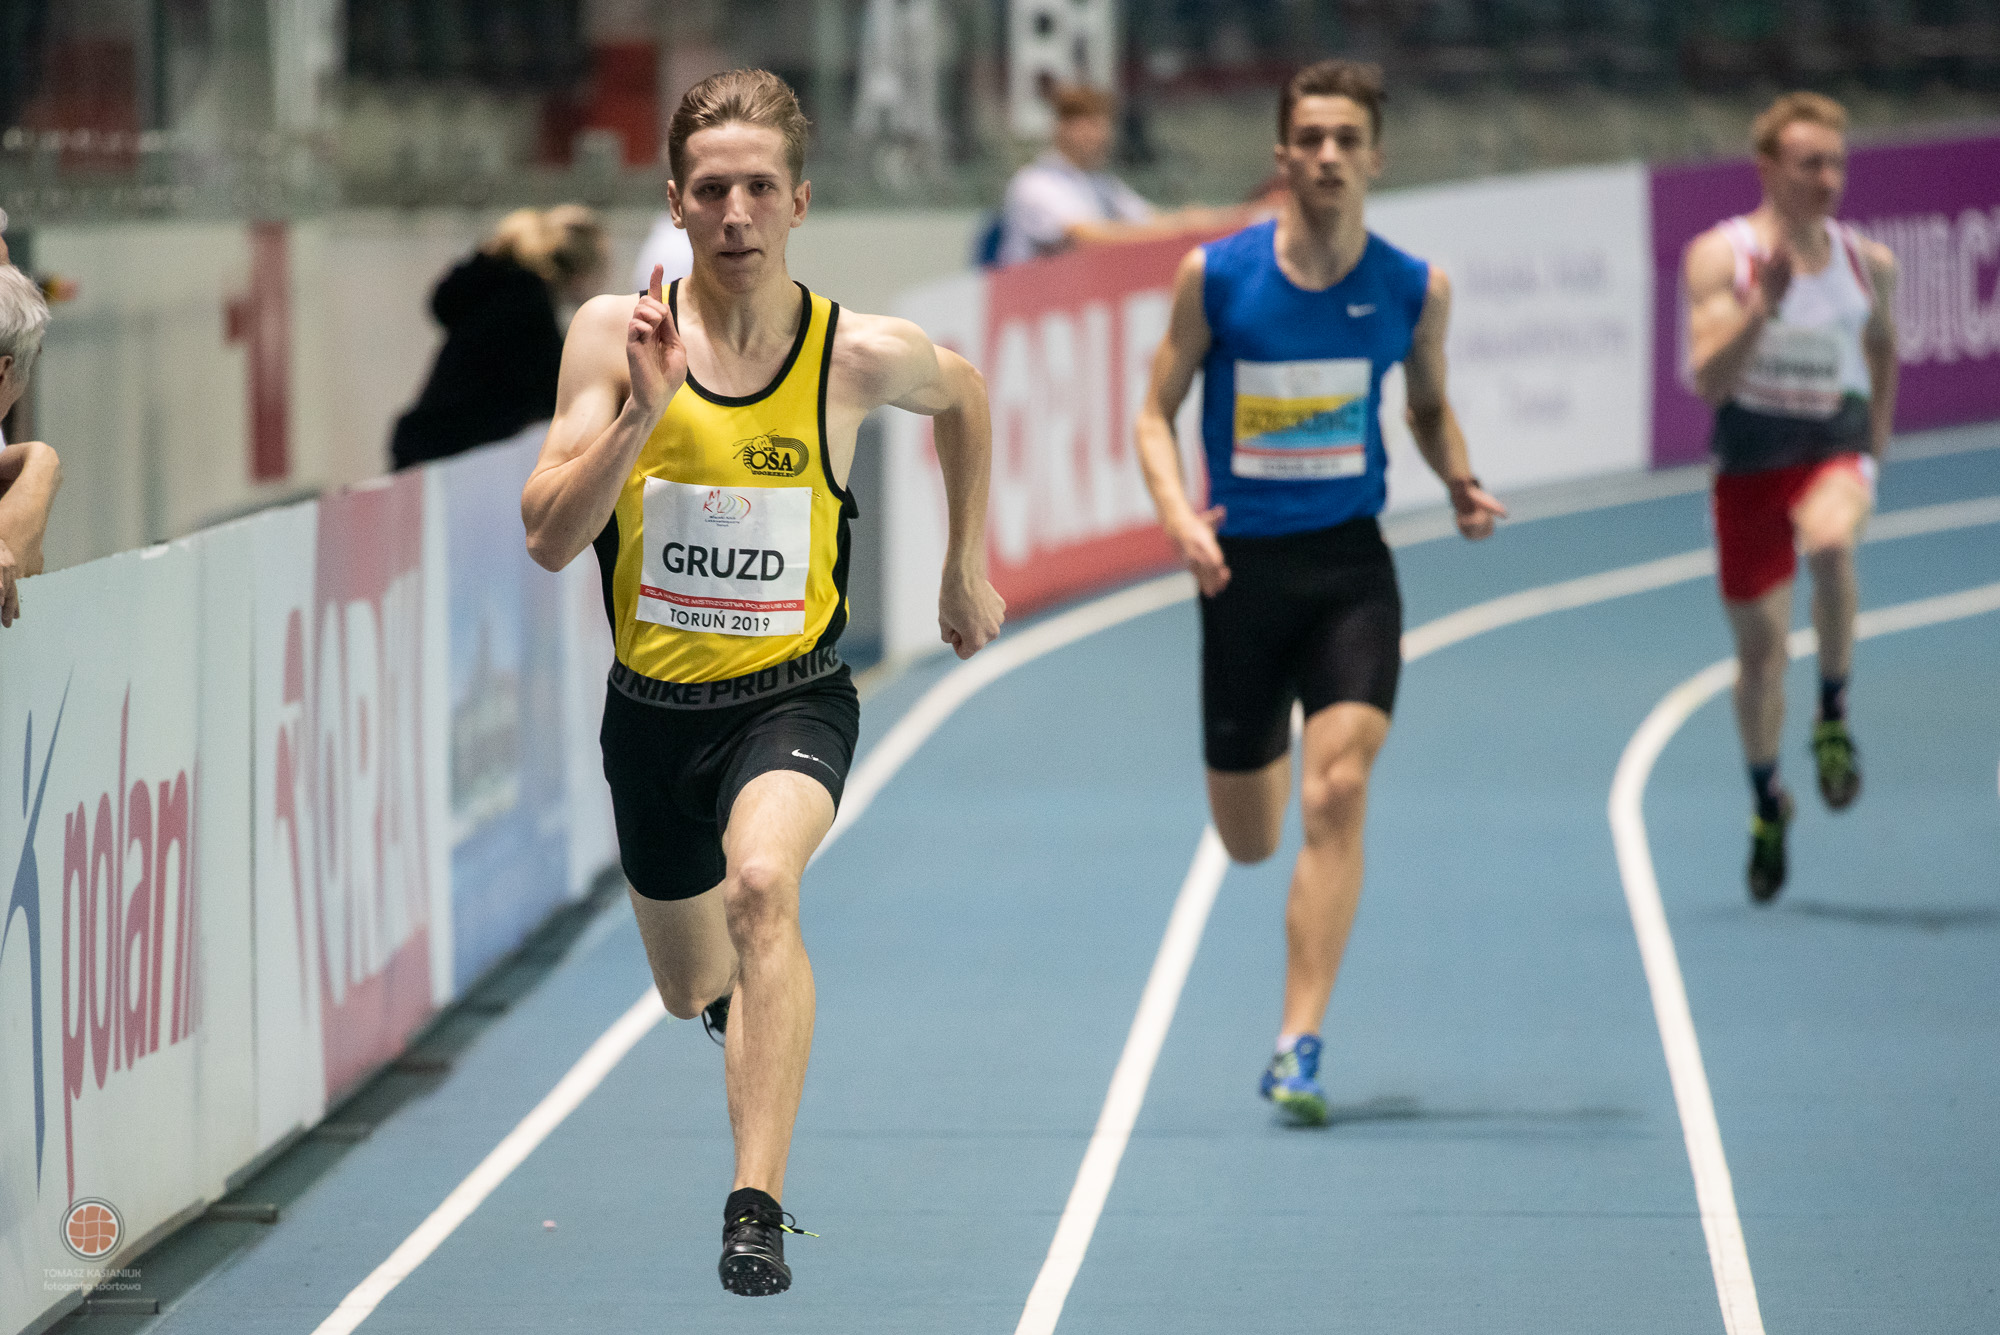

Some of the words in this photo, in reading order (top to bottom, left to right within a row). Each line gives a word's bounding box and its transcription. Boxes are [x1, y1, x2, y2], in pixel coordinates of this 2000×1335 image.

[751, 451, 793, 472] OSA
[662, 542, 785, 581] GRUZD
[670, 607, 725, 628] TORUŃ
[731, 615, 770, 632] 2019
[628, 674, 704, 704] NIKE
[709, 664, 779, 704] PRO
